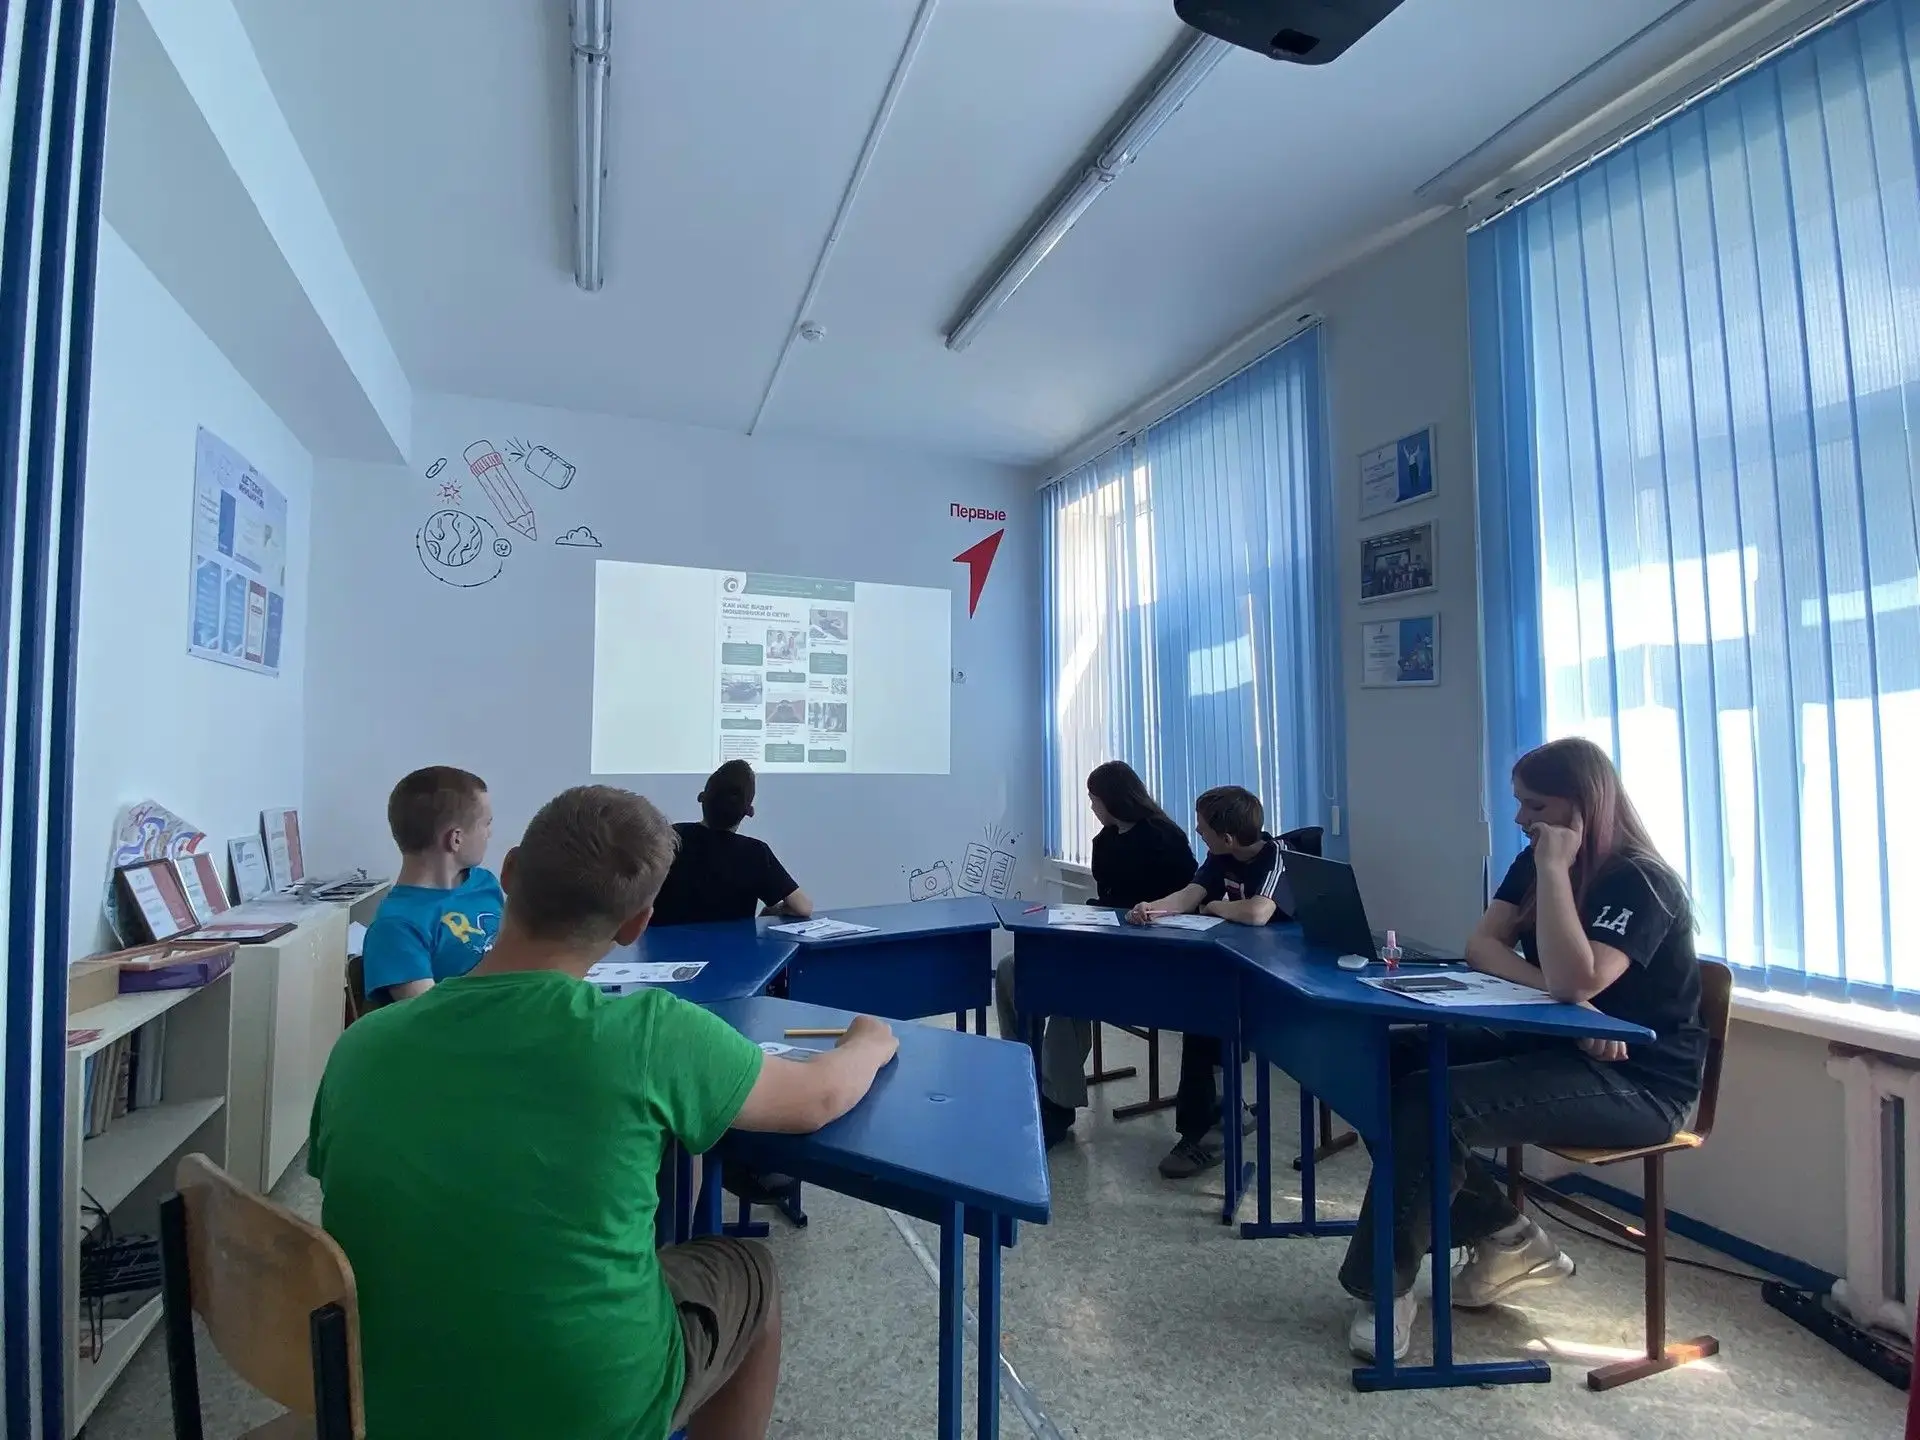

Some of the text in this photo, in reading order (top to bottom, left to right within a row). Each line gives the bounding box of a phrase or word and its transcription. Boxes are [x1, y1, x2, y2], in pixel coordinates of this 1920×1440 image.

[950, 503, 1006, 522] Первые
[722, 608, 765, 616] МОШЕННИКИ
[1592, 905, 1633, 936] LA
